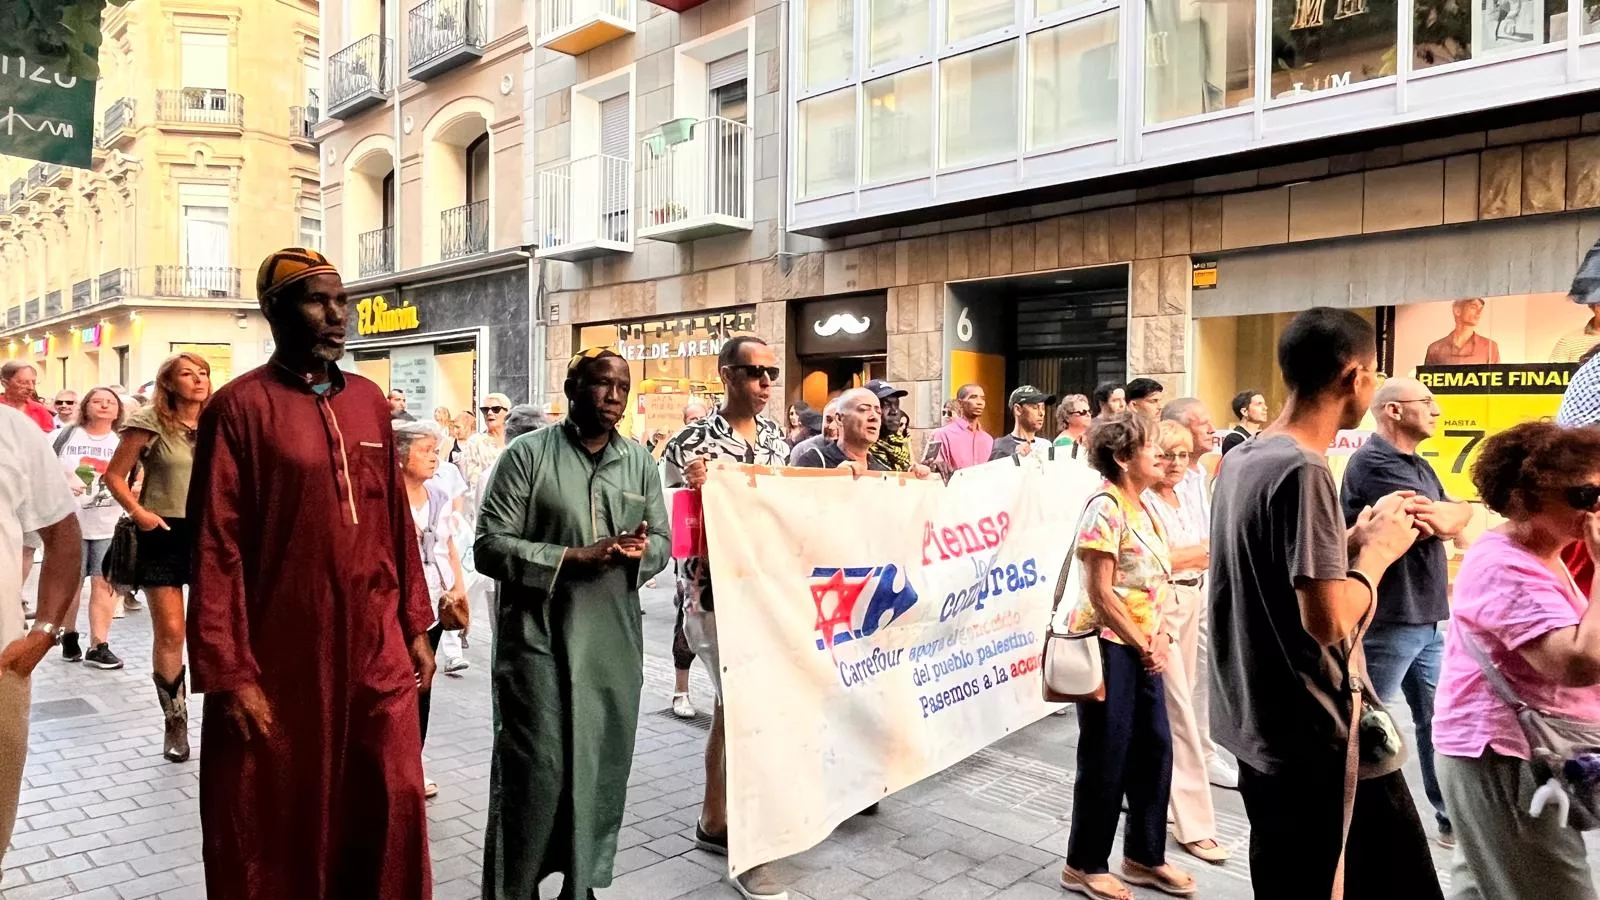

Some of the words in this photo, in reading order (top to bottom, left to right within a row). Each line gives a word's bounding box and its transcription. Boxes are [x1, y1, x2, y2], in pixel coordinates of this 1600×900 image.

[956, 306, 973, 342] 6
[651, 342, 670, 360] DE
[1419, 371, 1503, 388] REMATE
[1508, 371, 1572, 387] FINAL
[1443, 419, 1477, 427] HASTA
[921, 510, 1010, 566] Piensa
[839, 646, 904, 688] Carrefour
[908, 635, 945, 663] apoya
[912, 662, 930, 687] del
[932, 651, 975, 683] pueblo
[977, 630, 1039, 666] palestino.
[918, 677, 981, 719] Pasemos
[983, 674, 993, 690] a
[994, 665, 1009, 686] la
